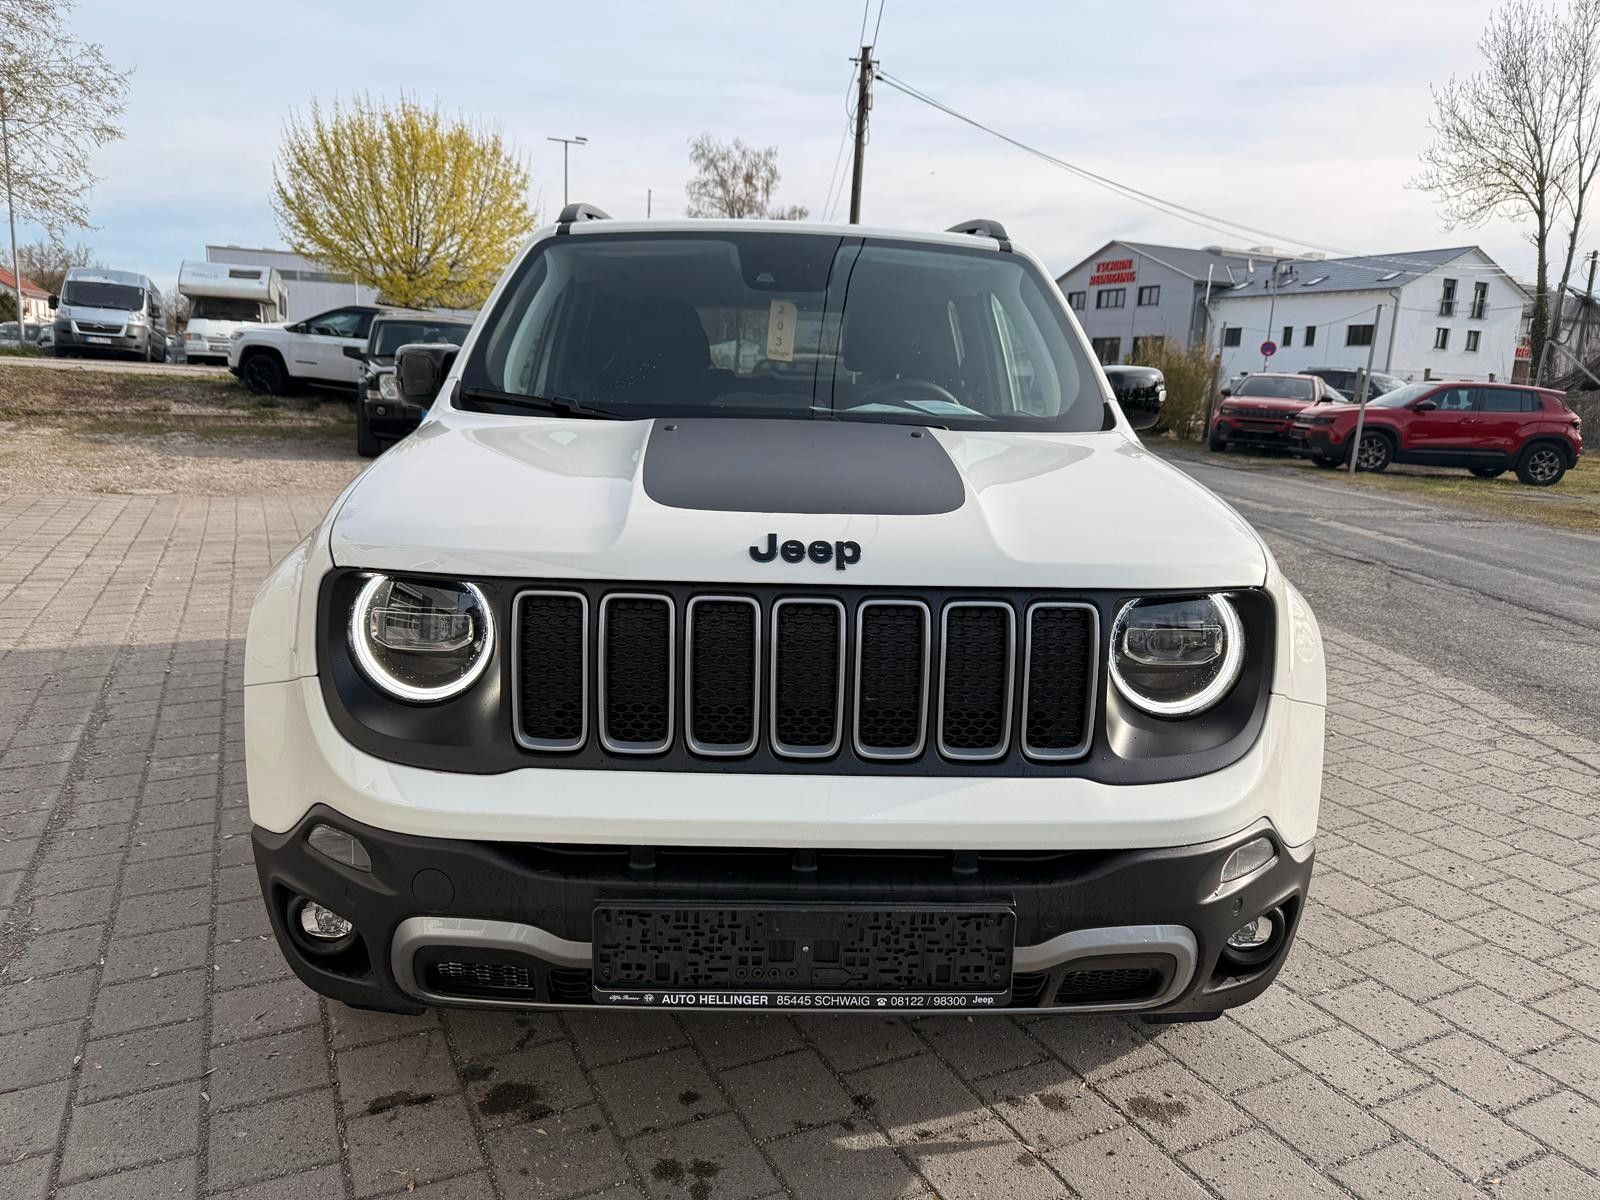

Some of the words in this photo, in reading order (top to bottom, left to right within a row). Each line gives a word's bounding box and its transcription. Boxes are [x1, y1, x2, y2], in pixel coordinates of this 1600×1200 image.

[749, 533, 861, 570] Jeep
[661, 994, 696, 1005] AUTO
[699, 995, 769, 1006] HELLINGER
[776, 995, 811, 1006] 85445
[814, 996, 870, 1007] SCHWAIG
[890, 997, 924, 1007] 08122
[933, 997, 967, 1007] 98300
[972, 995, 994, 1005] Jeep
